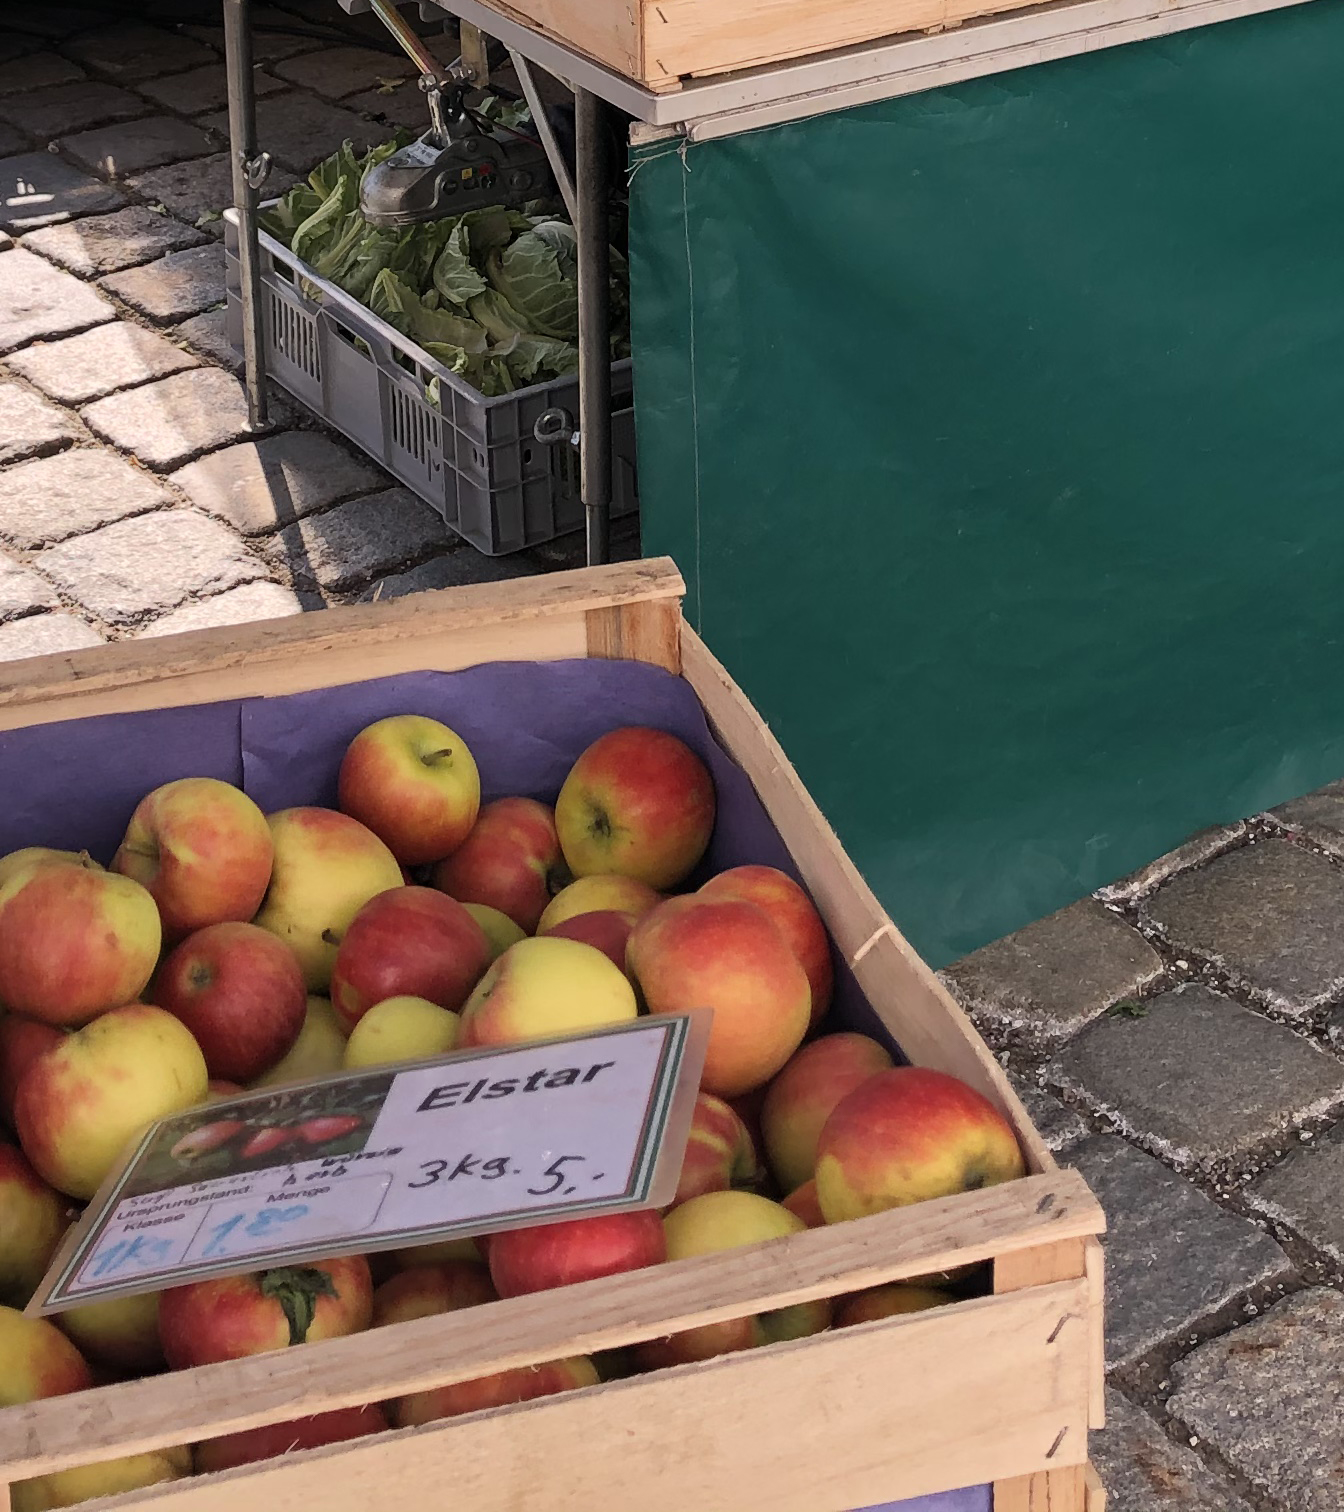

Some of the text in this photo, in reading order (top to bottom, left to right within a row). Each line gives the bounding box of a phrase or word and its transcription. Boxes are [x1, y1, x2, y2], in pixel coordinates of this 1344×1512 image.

[416, 1061, 616, 1112] Elstar
[123, 1185, 331, 1233] Klasse Menge
